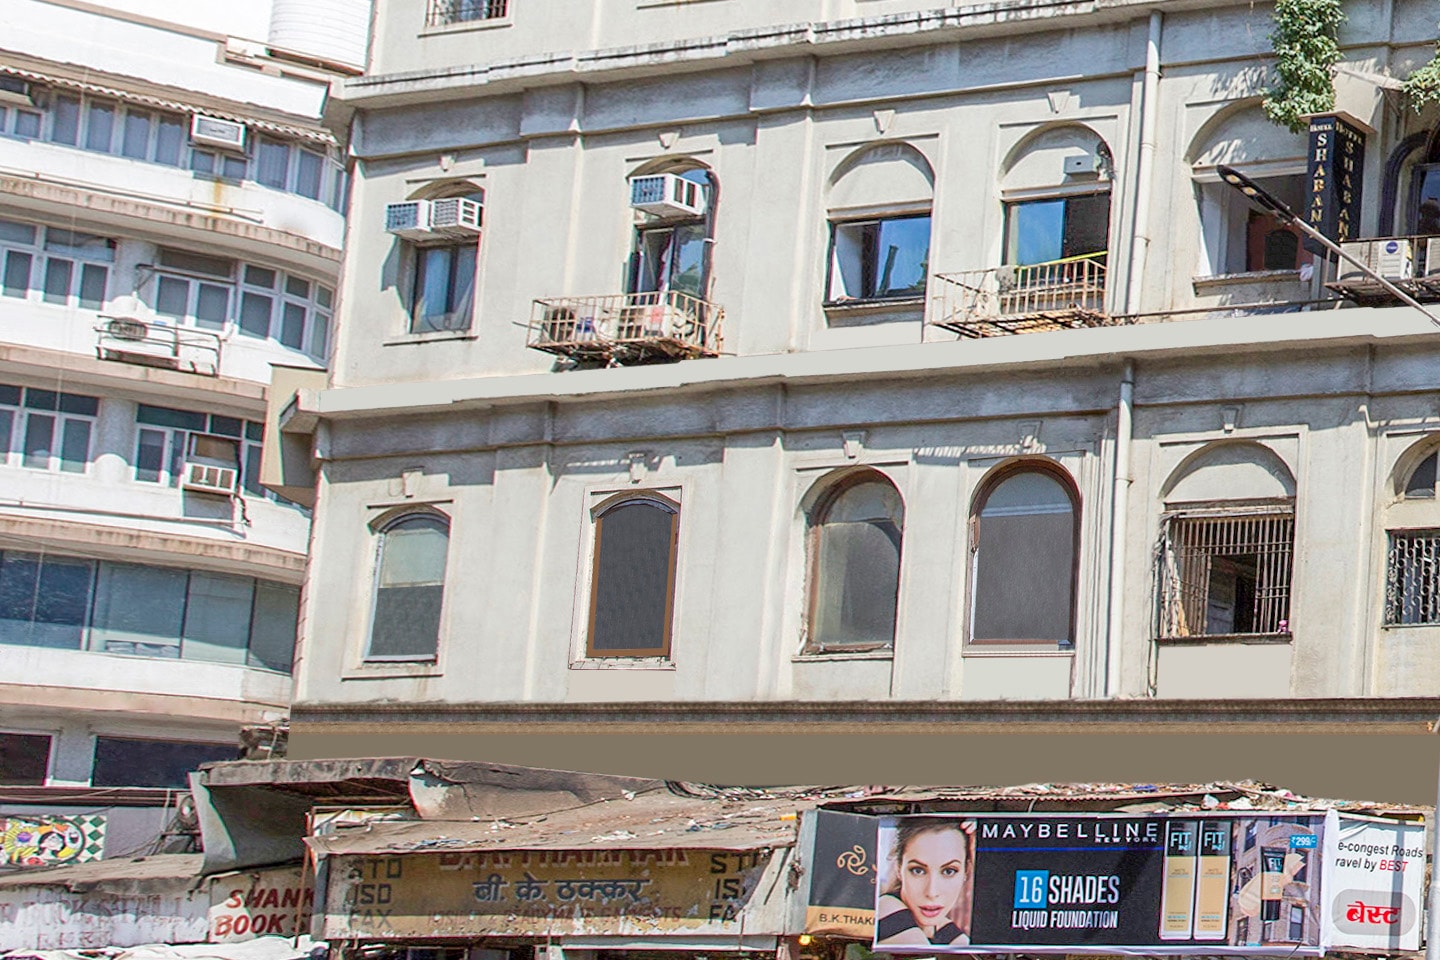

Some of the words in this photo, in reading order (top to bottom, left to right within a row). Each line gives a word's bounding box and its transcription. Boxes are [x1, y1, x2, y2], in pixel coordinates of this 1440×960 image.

[982, 822, 1158, 839] MAYBELLINE
[1170, 831, 1192, 848] FIT
[1204, 831, 1226, 848] FIT
[1391, 845, 1423, 858] Roads
[348, 858, 402, 879] STD
[1335, 857, 1360, 868] ravel
[1364, 859, 1377, 872] by
[1380, 860, 1408, 872] BEST
[554, 878, 653, 904] ठक्कर
[715, 878, 747, 900] IS
[1018, 876, 1044, 904] 16
[1048, 875, 1121, 905] SHADES
[709, 904, 738, 925] FA
[1012, 911, 1047, 929] LIQUID
[1050, 911, 1119, 929] FOUNDATION
[1346, 901, 1402, 925] बेस्ट
[214, 912, 288, 936] BOOK
